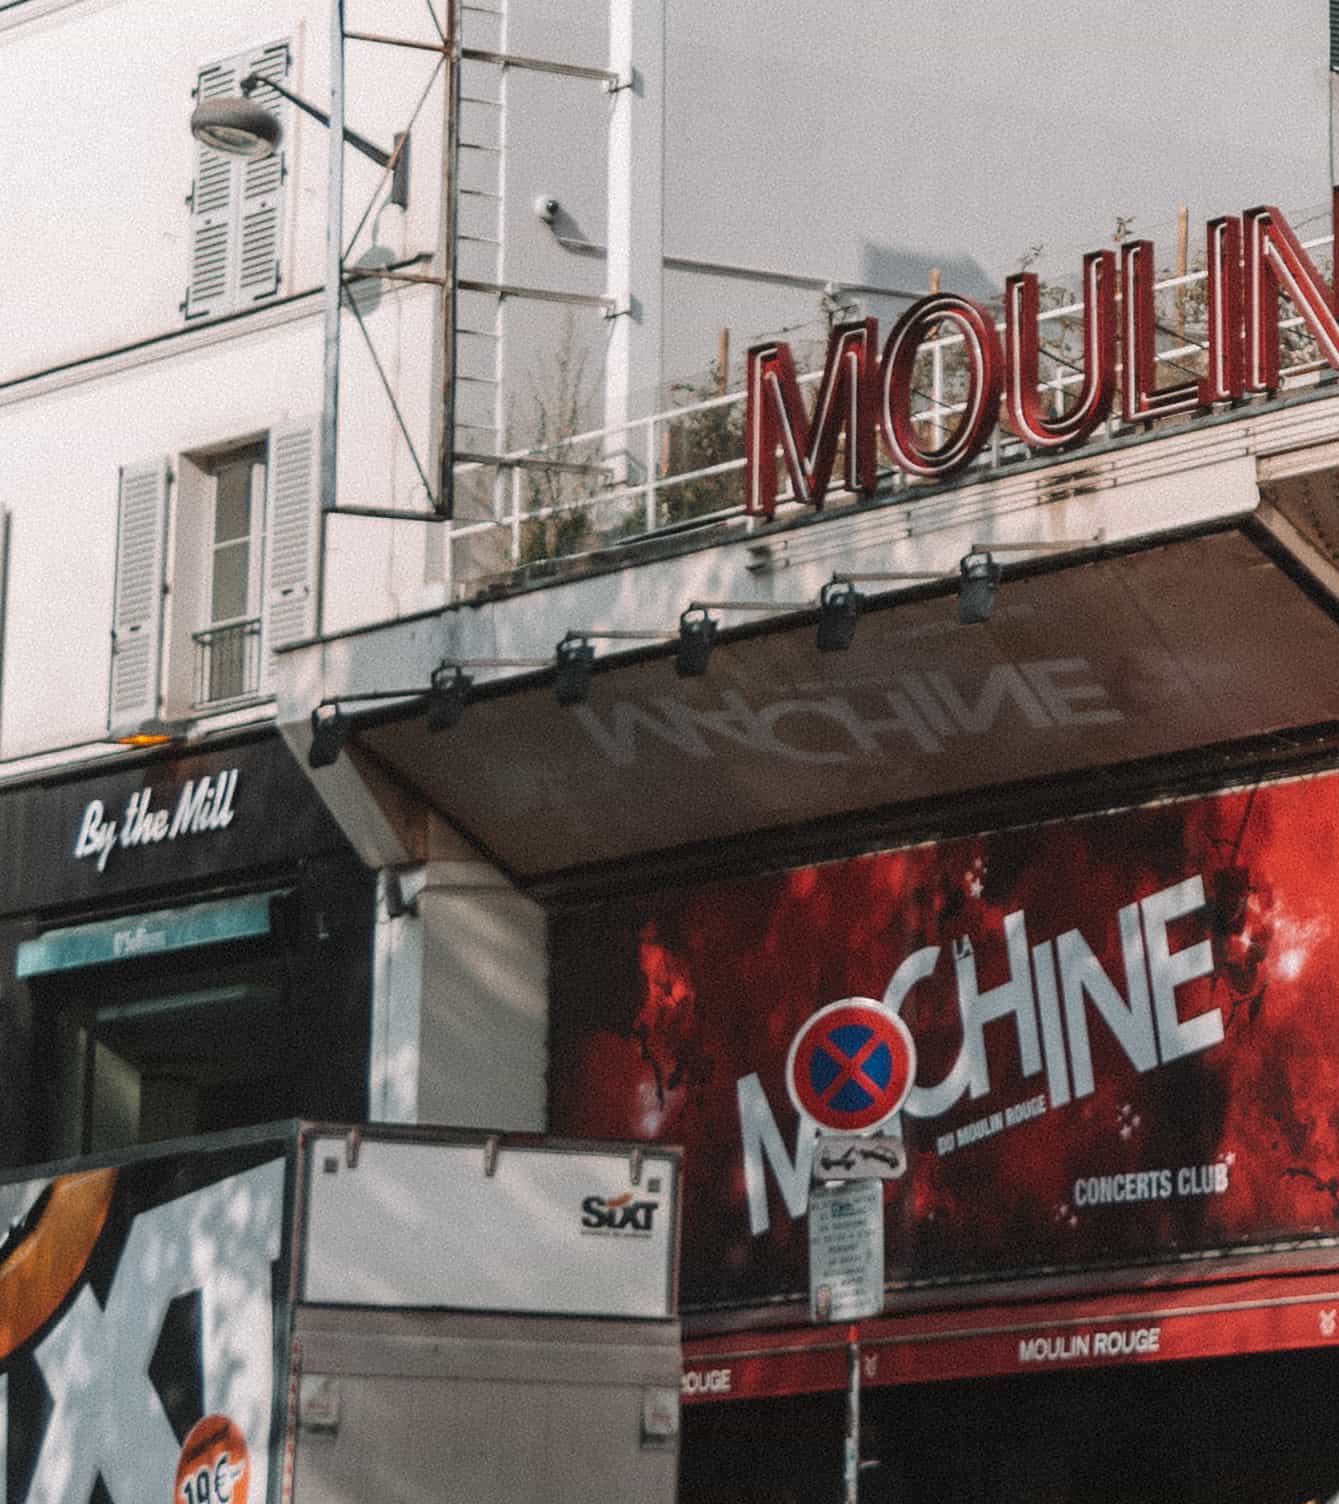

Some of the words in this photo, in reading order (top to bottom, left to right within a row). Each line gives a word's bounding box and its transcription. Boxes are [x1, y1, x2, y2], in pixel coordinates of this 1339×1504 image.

[75, 799, 117, 872] By
[121, 787, 169, 848] the
[169, 768, 239, 839] Mill
[736, 874, 1225, 1236] MCHINE
[957, 1111, 1004, 1147] MOULIN
[1005, 1095, 1046, 1128] ROUGE
[1074, 1169, 1172, 1207] CONCERTS
[1177, 1162, 1229, 1194] CLUB
[1019, 1332, 1090, 1363] MOULIN
[1093, 1327, 1161, 1357] ROUGE
